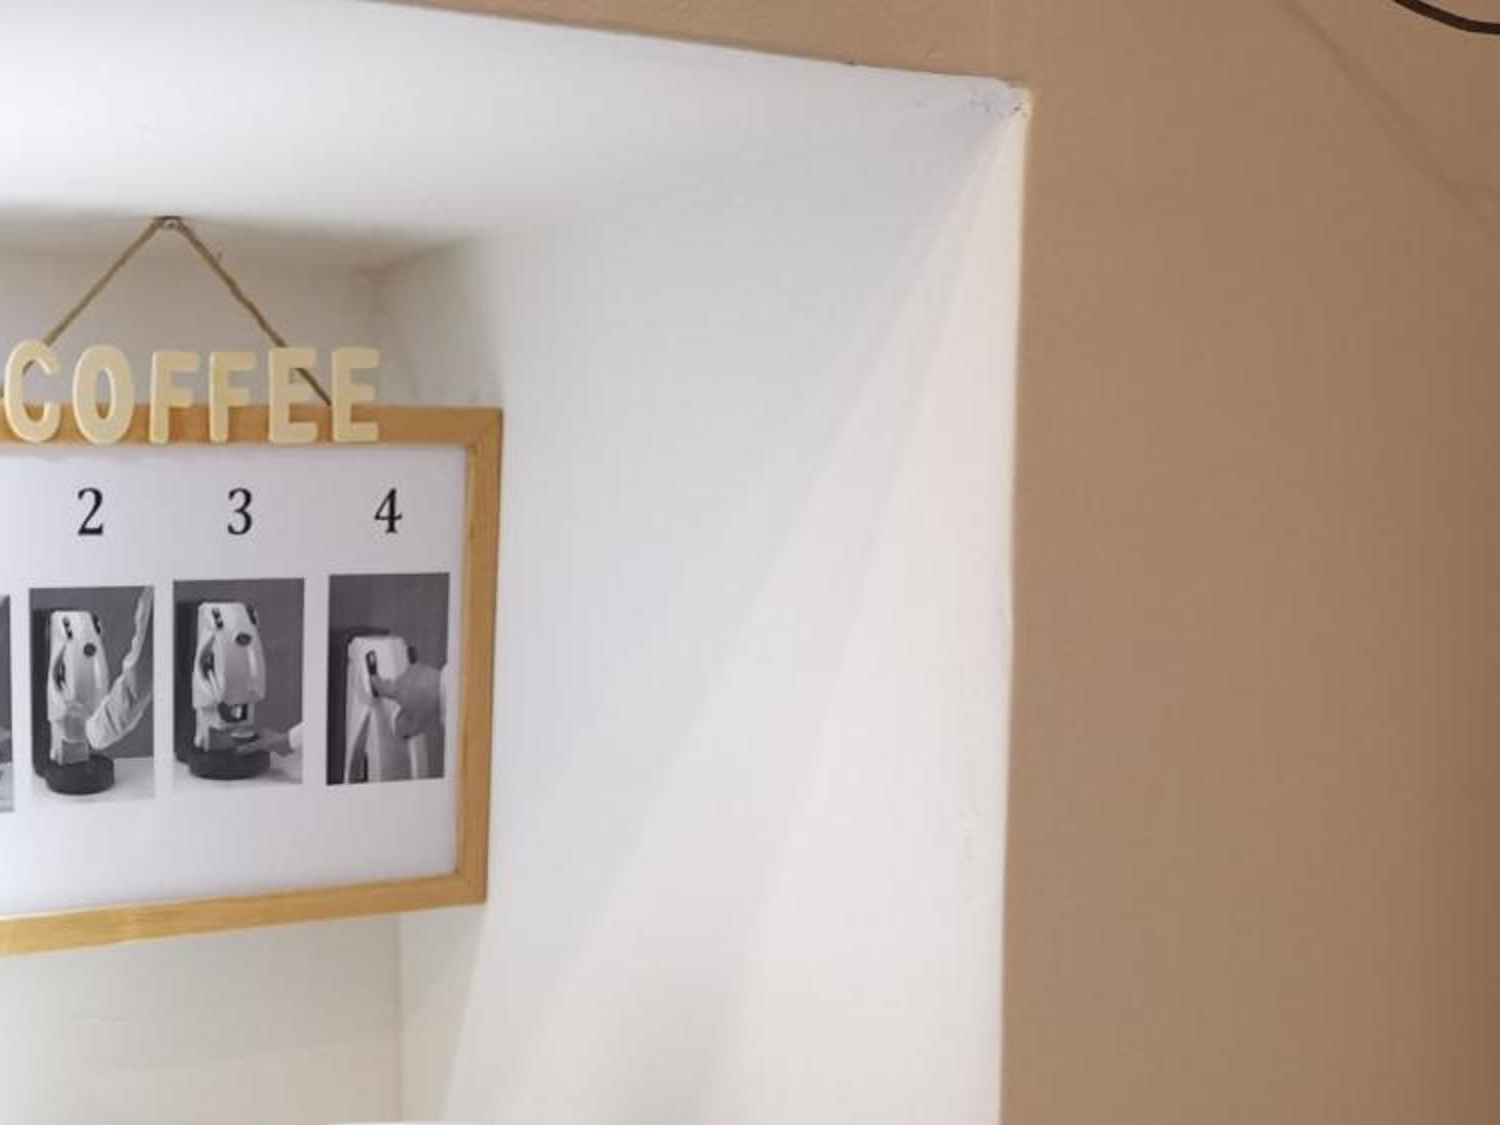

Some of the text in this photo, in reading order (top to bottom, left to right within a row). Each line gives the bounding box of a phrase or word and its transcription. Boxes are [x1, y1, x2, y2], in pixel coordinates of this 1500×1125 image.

[4, 340, 380, 444] COFFEE
[77, 487, 104, 536] 2
[227, 487, 253, 536] 3
[374, 487, 402, 534] 4
